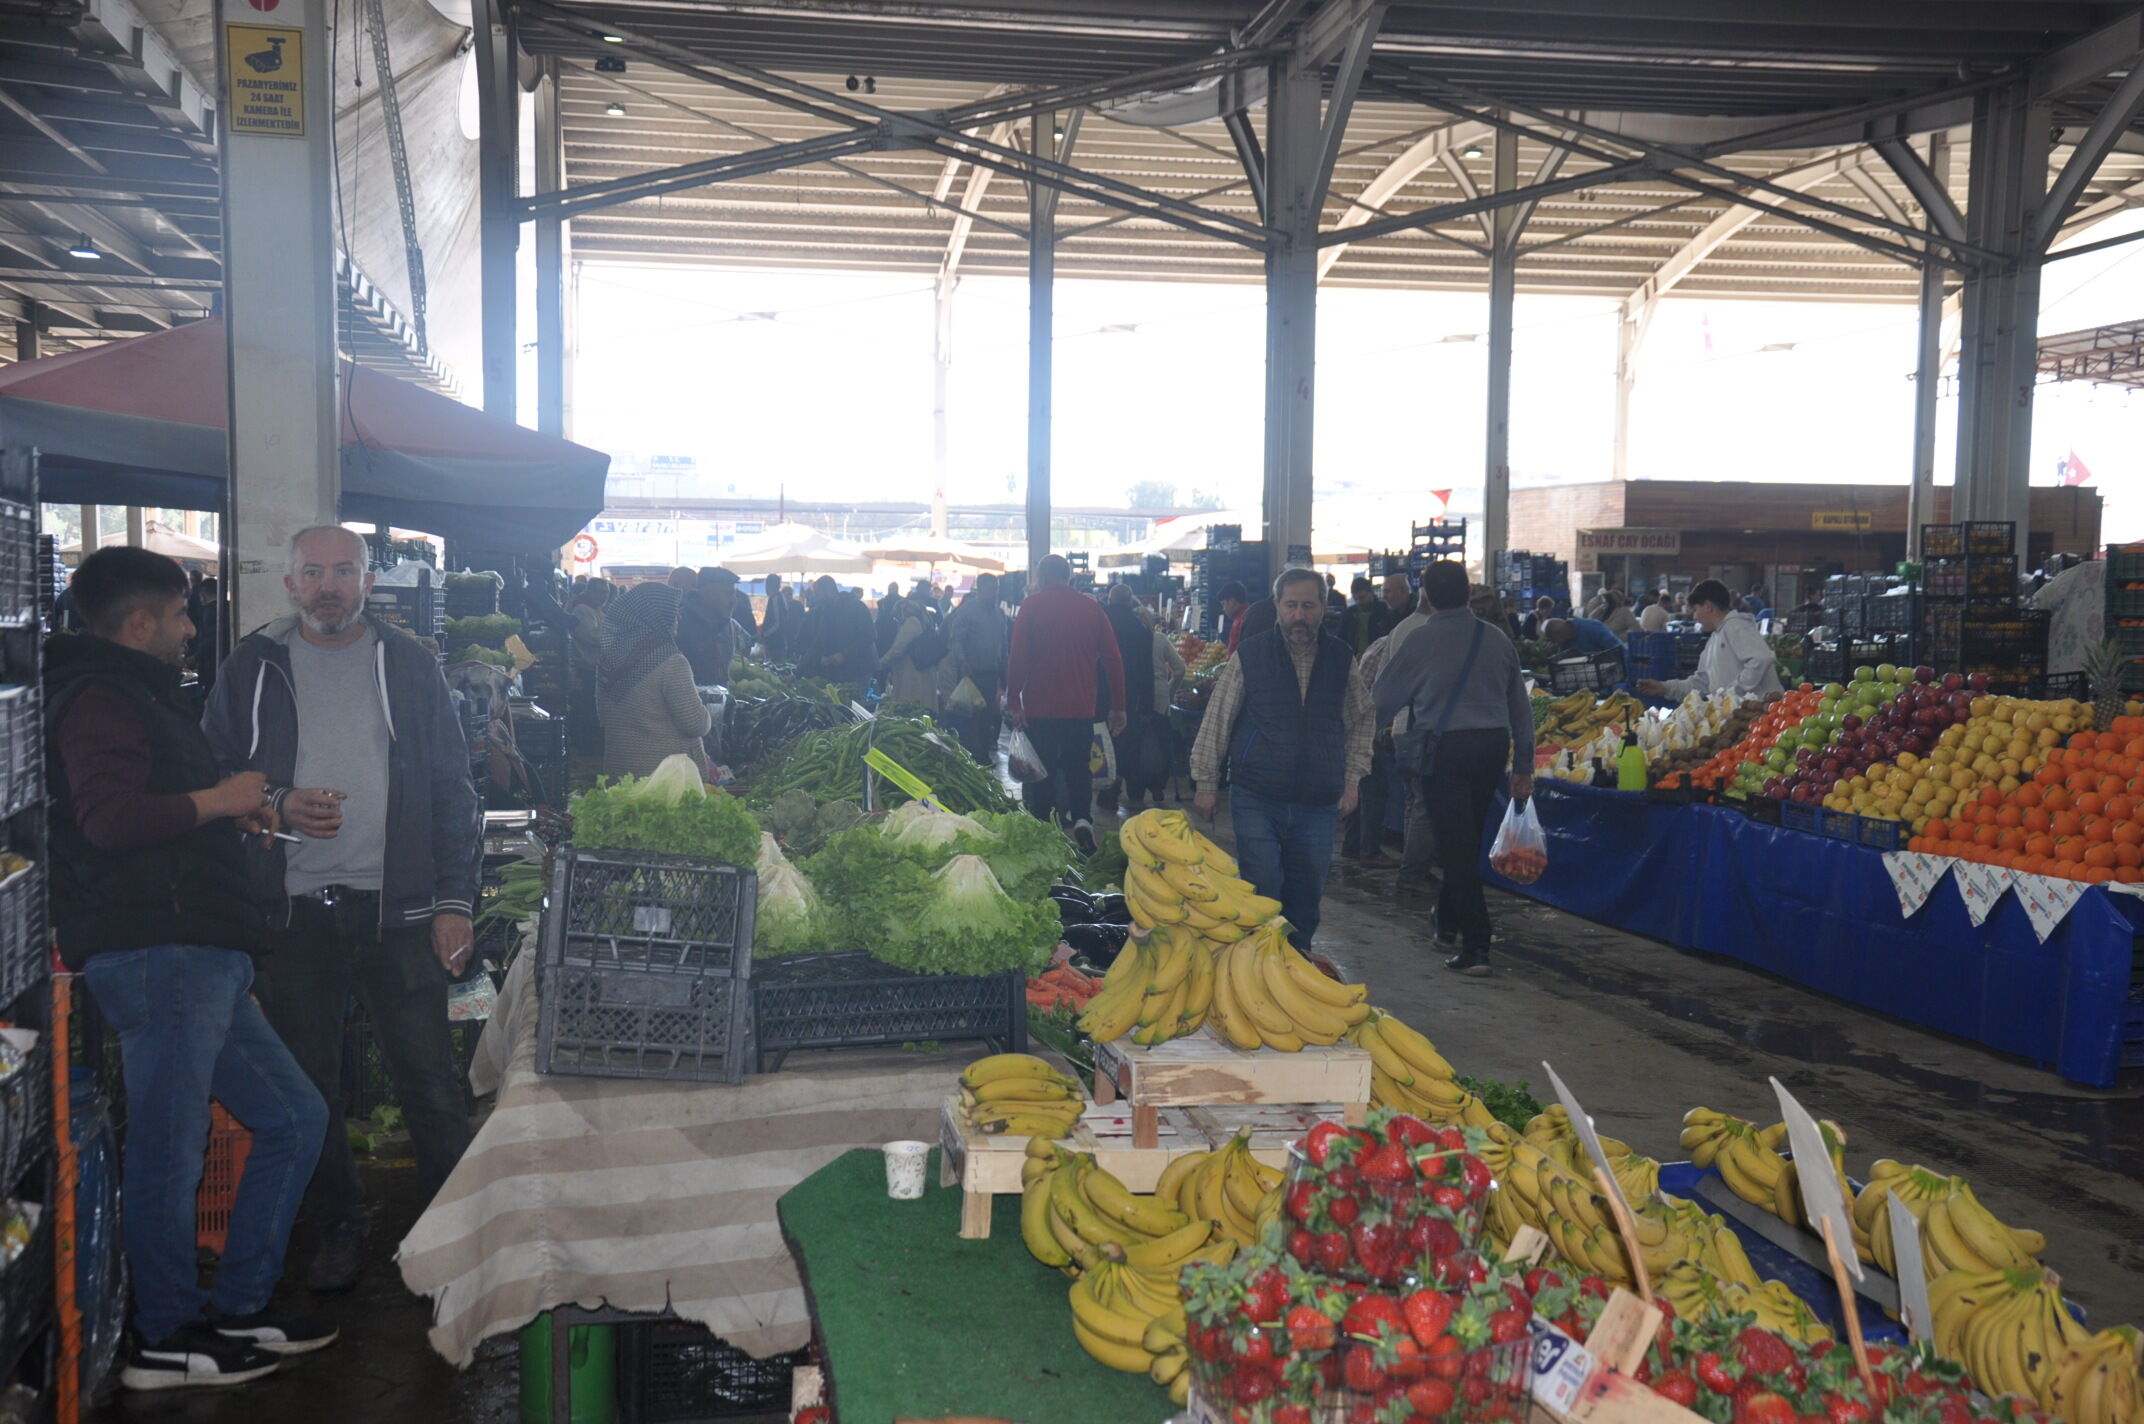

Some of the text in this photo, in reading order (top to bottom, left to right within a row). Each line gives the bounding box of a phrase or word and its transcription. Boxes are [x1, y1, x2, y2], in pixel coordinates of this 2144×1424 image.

[237, 79, 297, 91] PAZARYERİMİZ
[250, 92, 284, 104] 24 SAAT
[244, 105, 279, 115] KAMERA
[236, 116, 300, 129] İZLENMEKTEDİR
[2018, 386, 2029, 408] 3
[1581, 534, 1615, 548] ESNAF
[1641, 532, 1676, 549] OCAĞI
